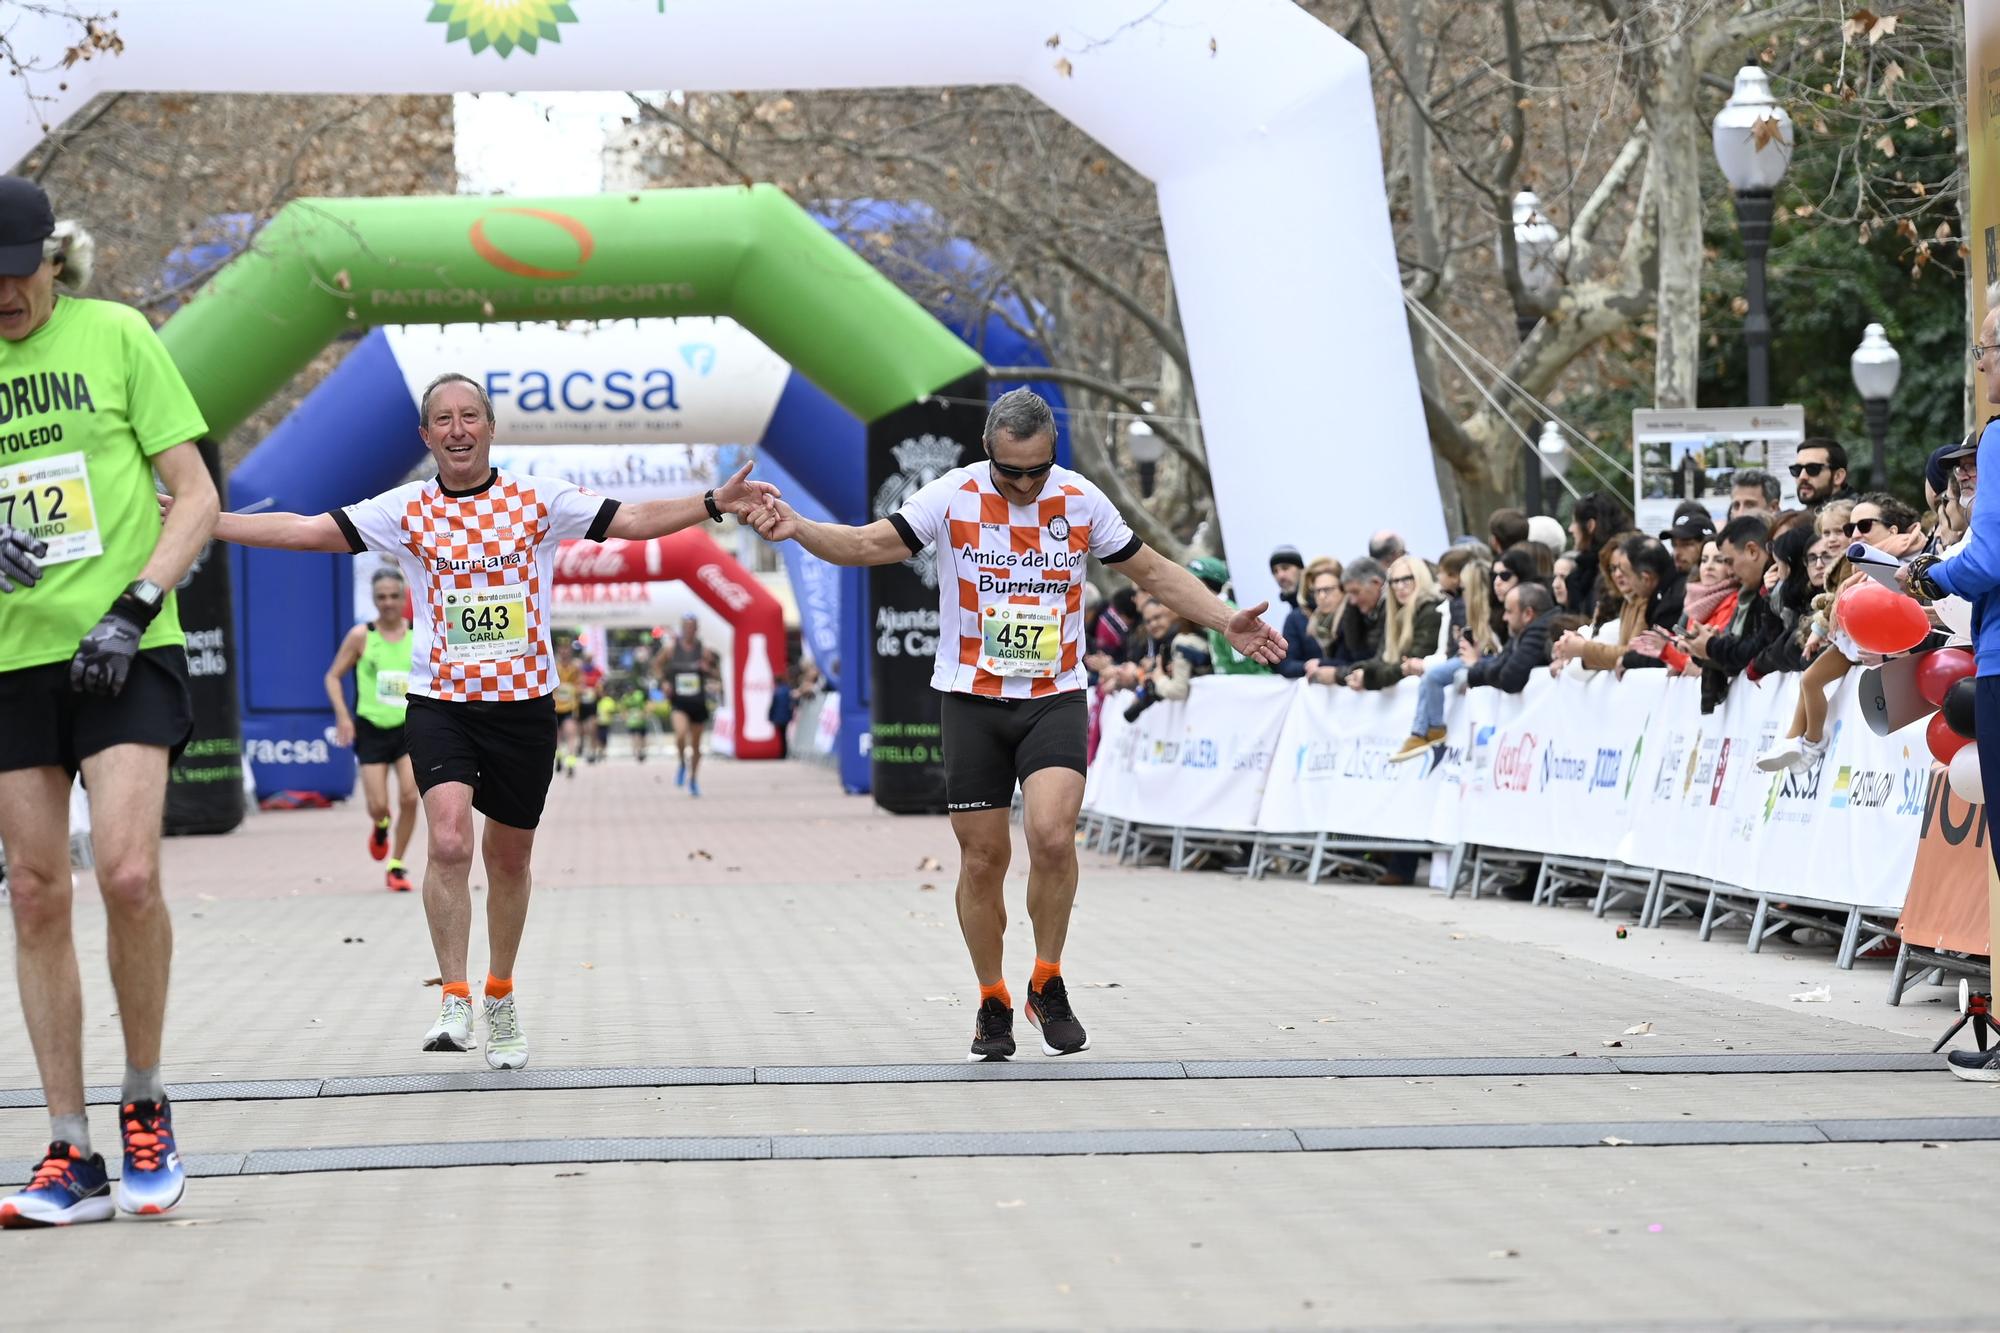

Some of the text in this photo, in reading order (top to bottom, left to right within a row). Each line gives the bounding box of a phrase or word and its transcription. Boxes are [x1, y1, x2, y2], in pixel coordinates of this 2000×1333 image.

[0, 423, 63, 455] TOLEDO
[435, 553, 521, 571] Burriana
[962, 546, 1082, 568] Amics del Clot
[979, 574, 1069, 594] Burriana
[461, 605, 509, 633] 643
[469, 631, 504, 642] CARLA
[877, 631, 901, 657] de
[996, 623, 1044, 650] 457
